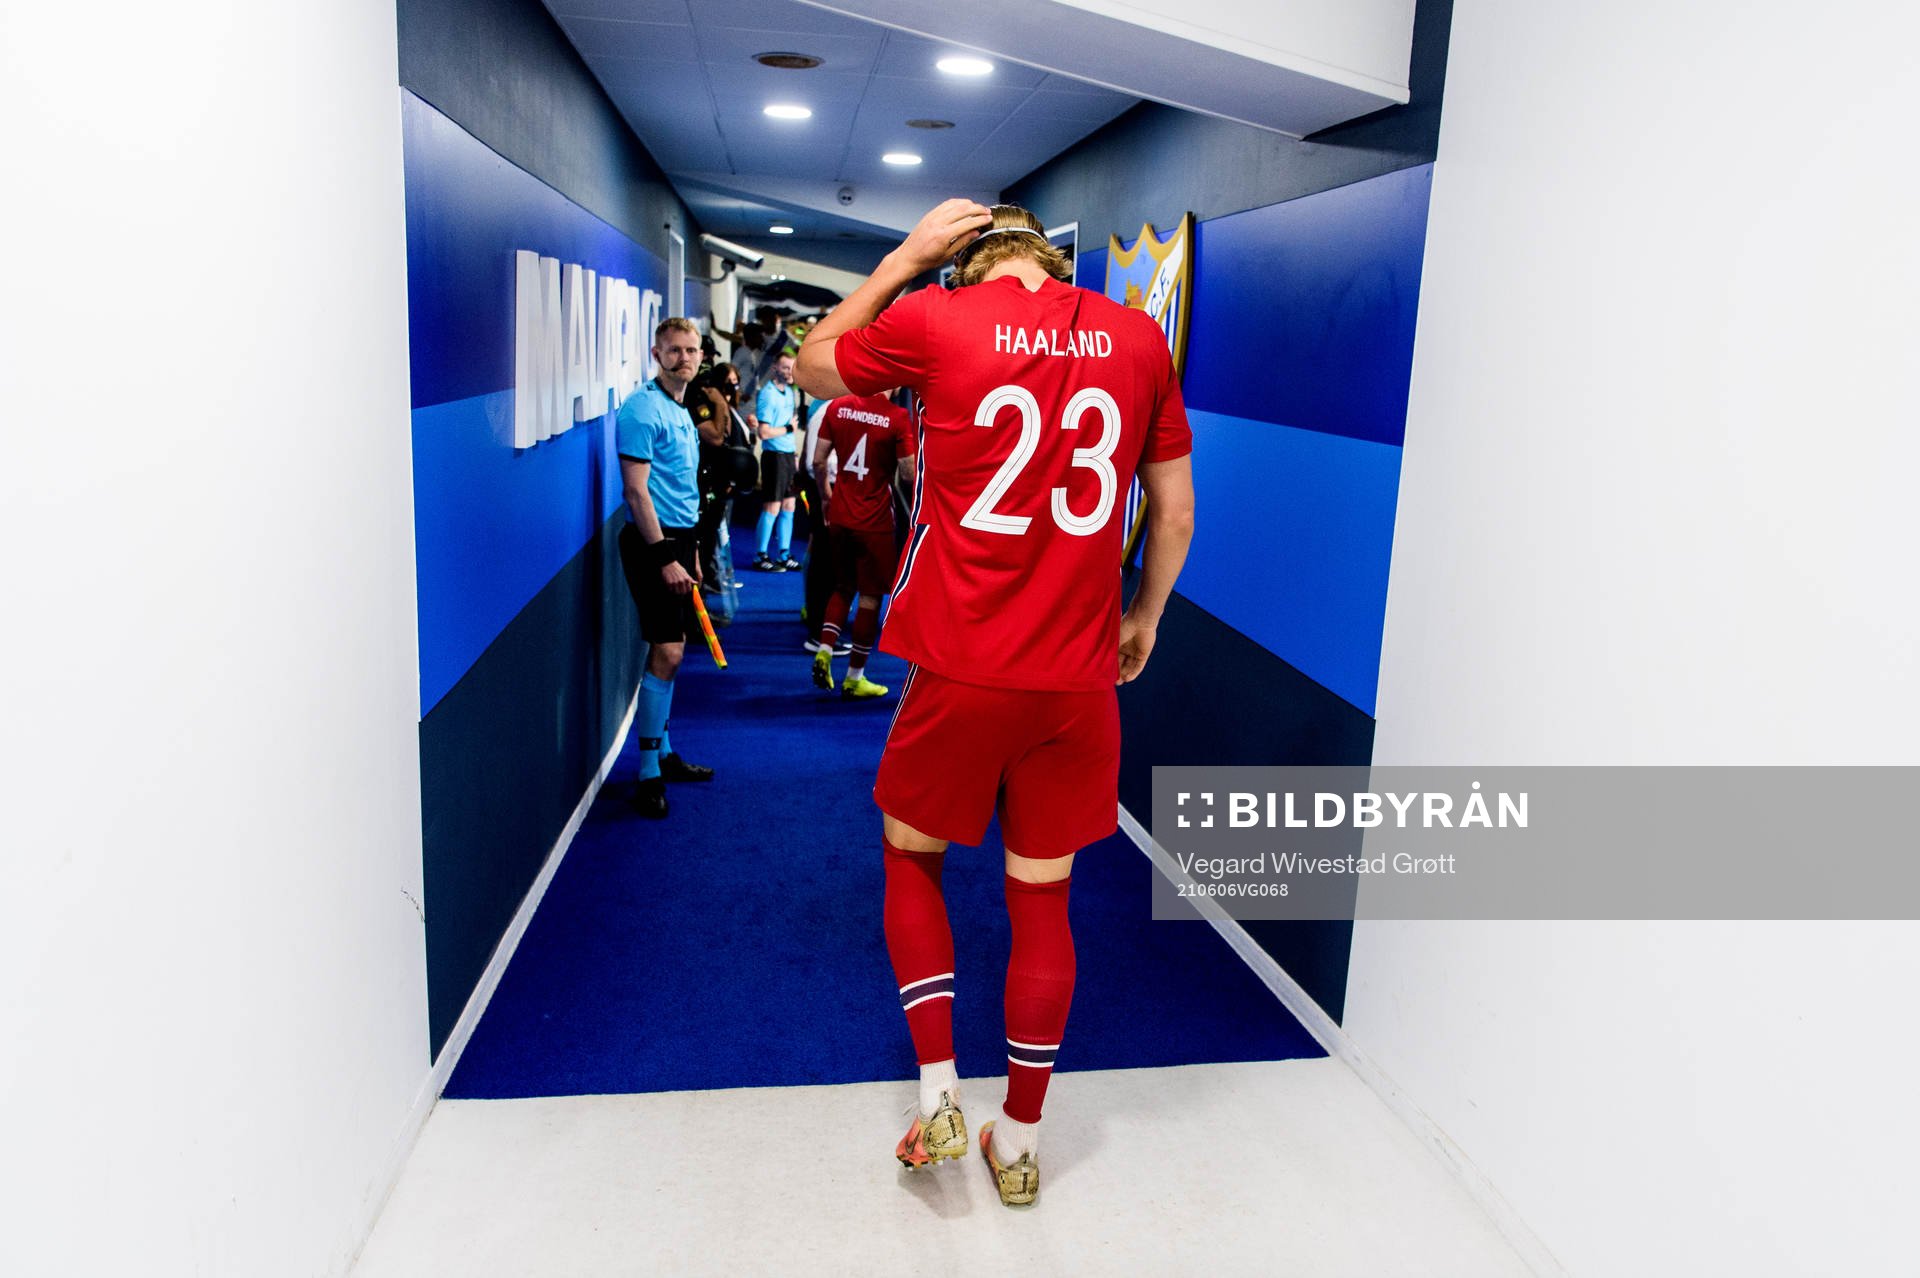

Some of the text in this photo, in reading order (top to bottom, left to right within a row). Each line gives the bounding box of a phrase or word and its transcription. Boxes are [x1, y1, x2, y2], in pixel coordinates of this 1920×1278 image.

[995, 324, 1113, 359] HAALAND
[837, 407, 890, 428] STRANDBERG
[843, 432, 870, 481] 4
[960, 384, 1122, 537] 23
